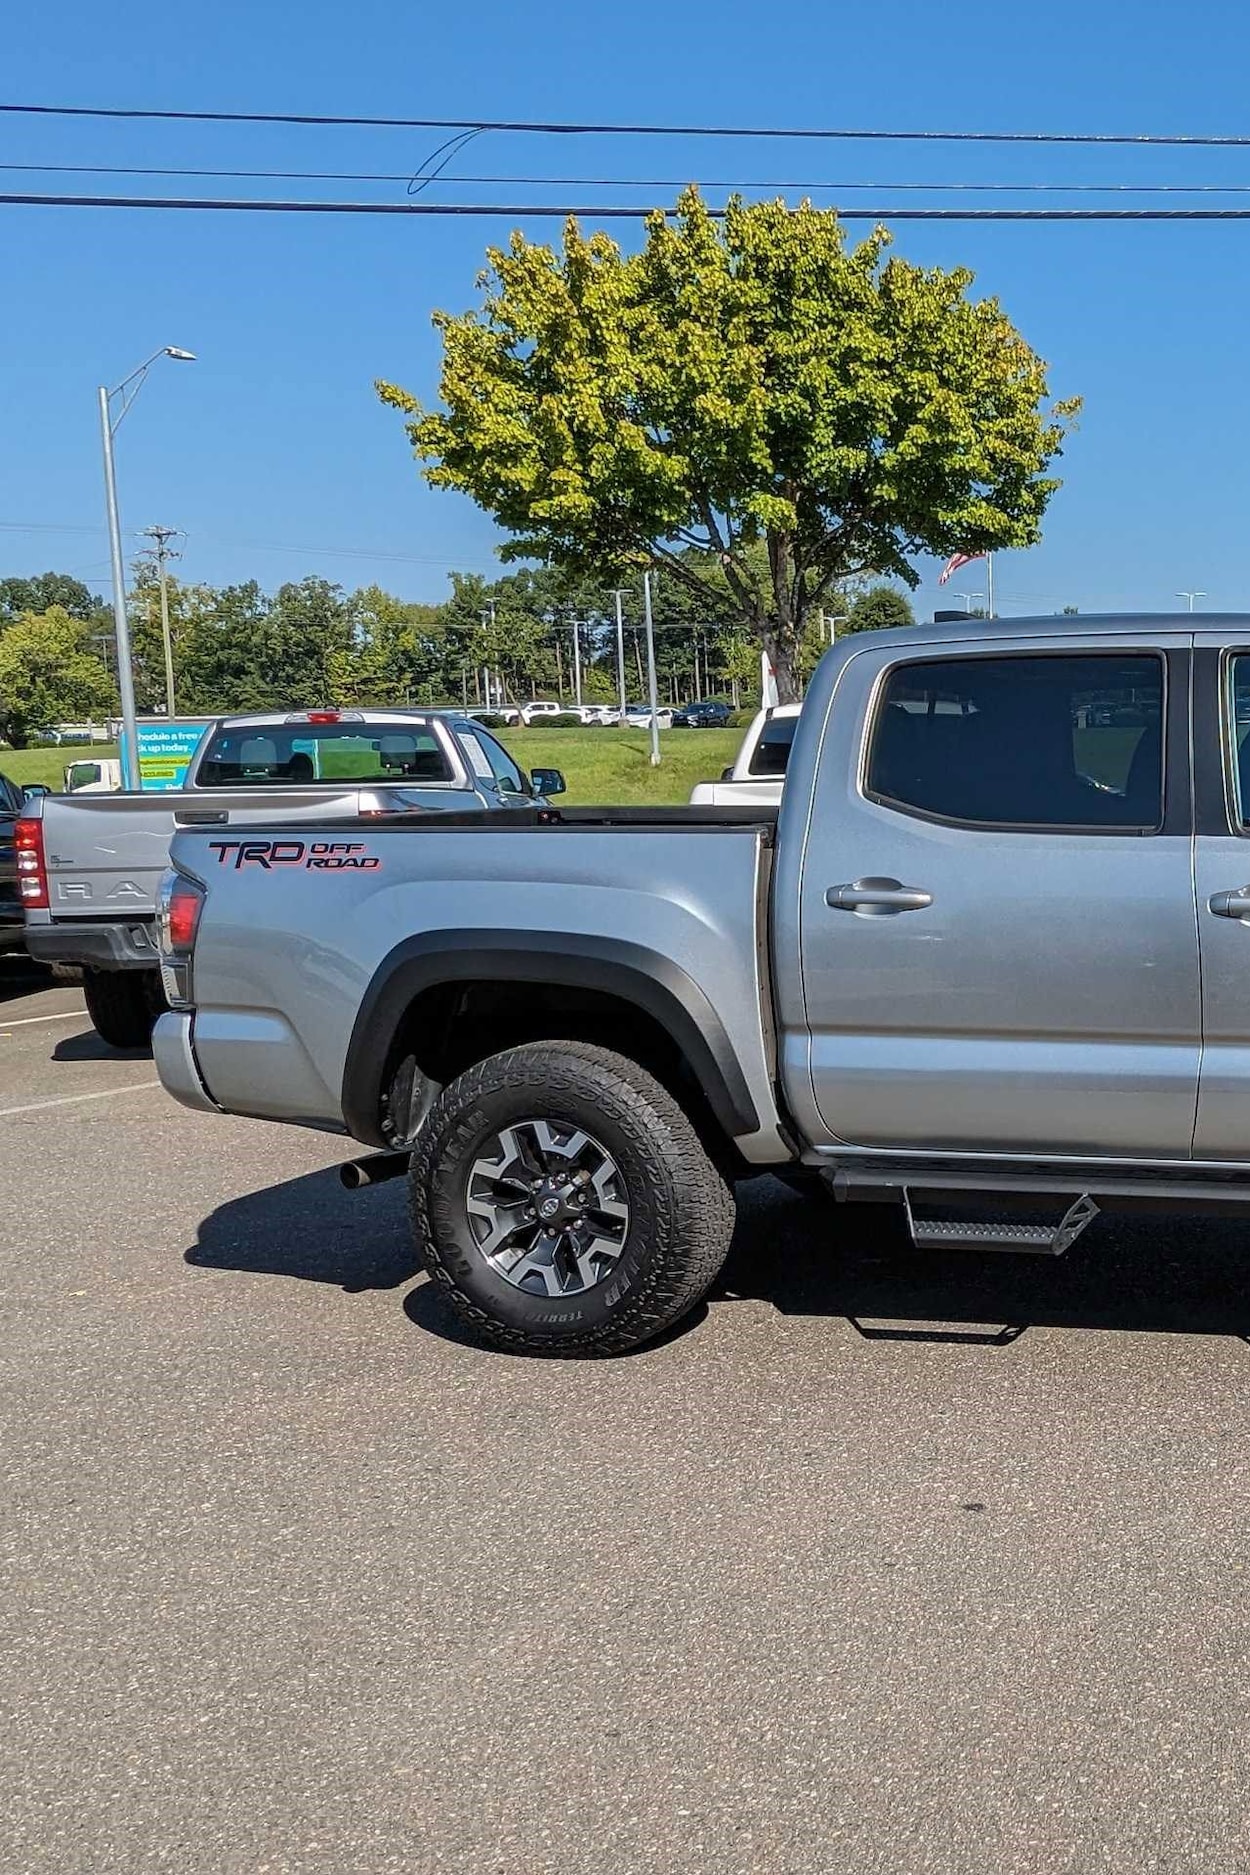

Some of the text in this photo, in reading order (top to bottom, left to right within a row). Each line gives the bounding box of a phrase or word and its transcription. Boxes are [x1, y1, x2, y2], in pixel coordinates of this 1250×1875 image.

[138, 732, 170, 741] hedule
[209, 841, 365, 869] TRD OFF
[306, 858, 380, 869] ROAD
[58, 881, 149, 899] RA
